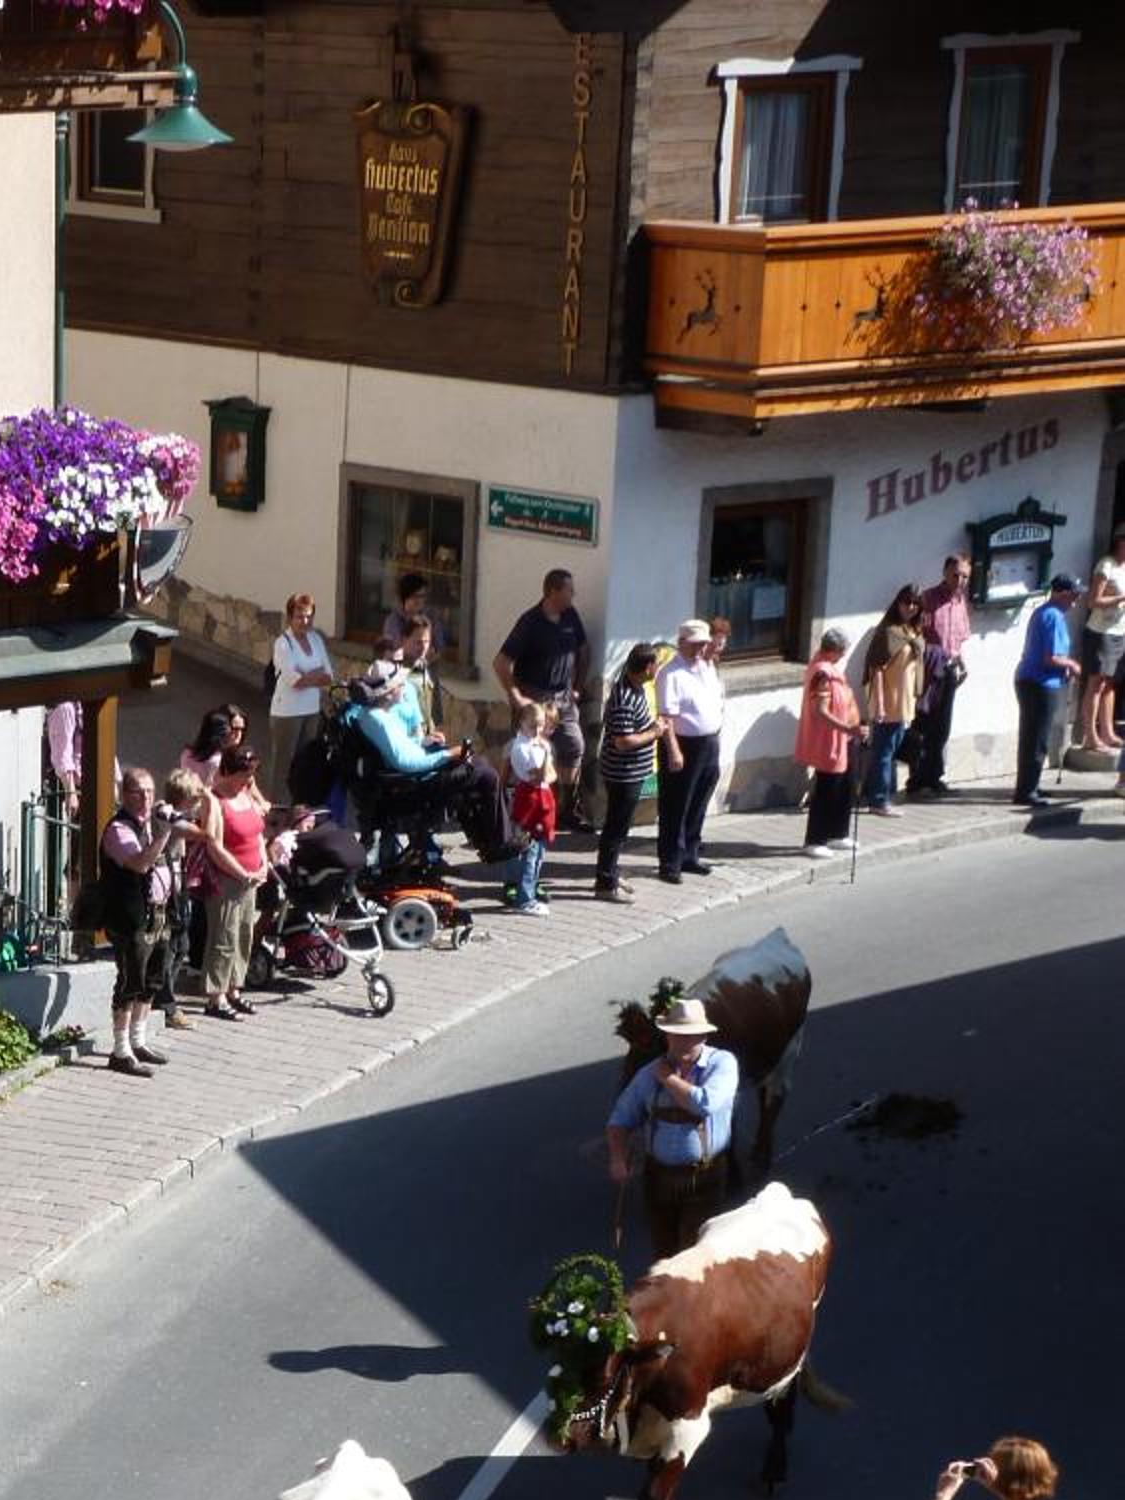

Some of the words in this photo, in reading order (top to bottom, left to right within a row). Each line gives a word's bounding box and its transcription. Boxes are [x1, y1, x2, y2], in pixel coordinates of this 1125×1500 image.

[364, 157, 439, 195] Hubertus
[562, 32, 592, 377] ESTAURANT
[865, 417, 1059, 522] Hubertus
